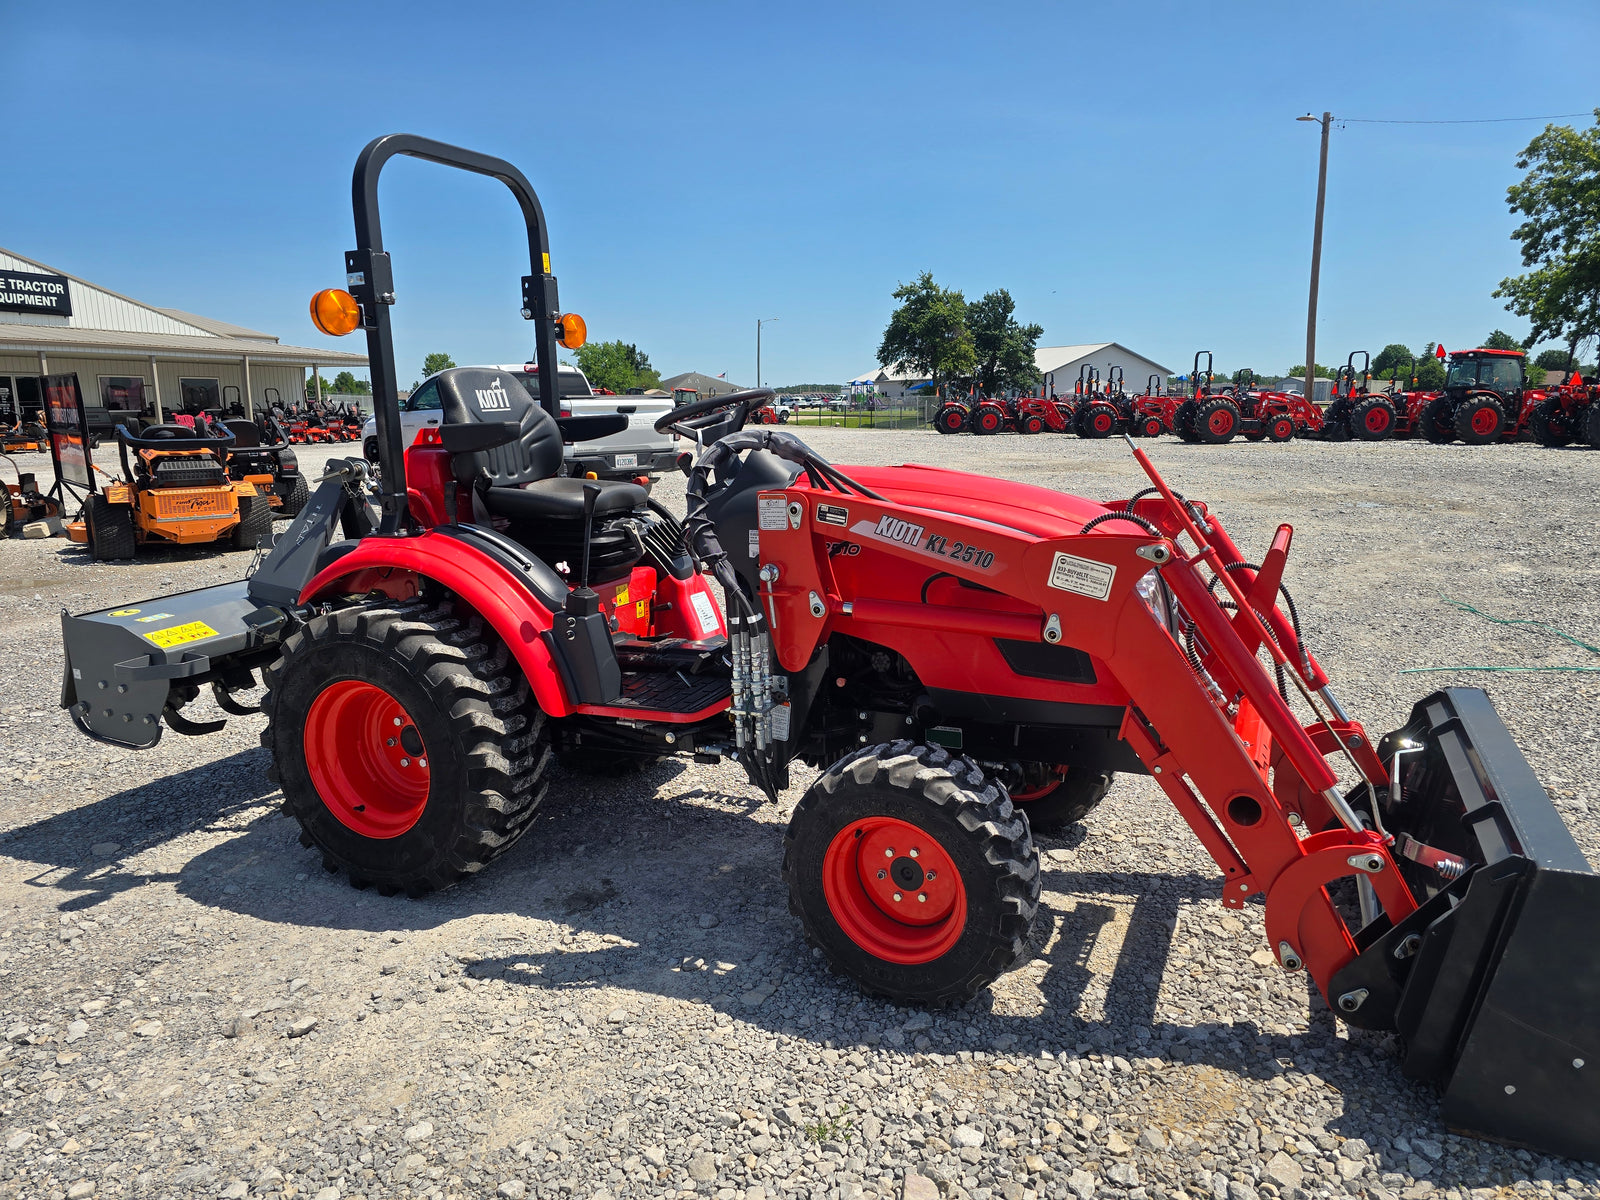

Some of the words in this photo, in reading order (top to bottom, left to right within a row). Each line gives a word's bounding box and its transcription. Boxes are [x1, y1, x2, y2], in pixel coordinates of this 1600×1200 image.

[8, 278, 65, 295] TRACTOR
[0, 291, 58, 307] QUIPMENT
[475, 388, 510, 409] KIOTI
[874, 513, 925, 547] KIOTI
[925, 533, 948, 555] KL
[949, 541, 995, 569] 2510
